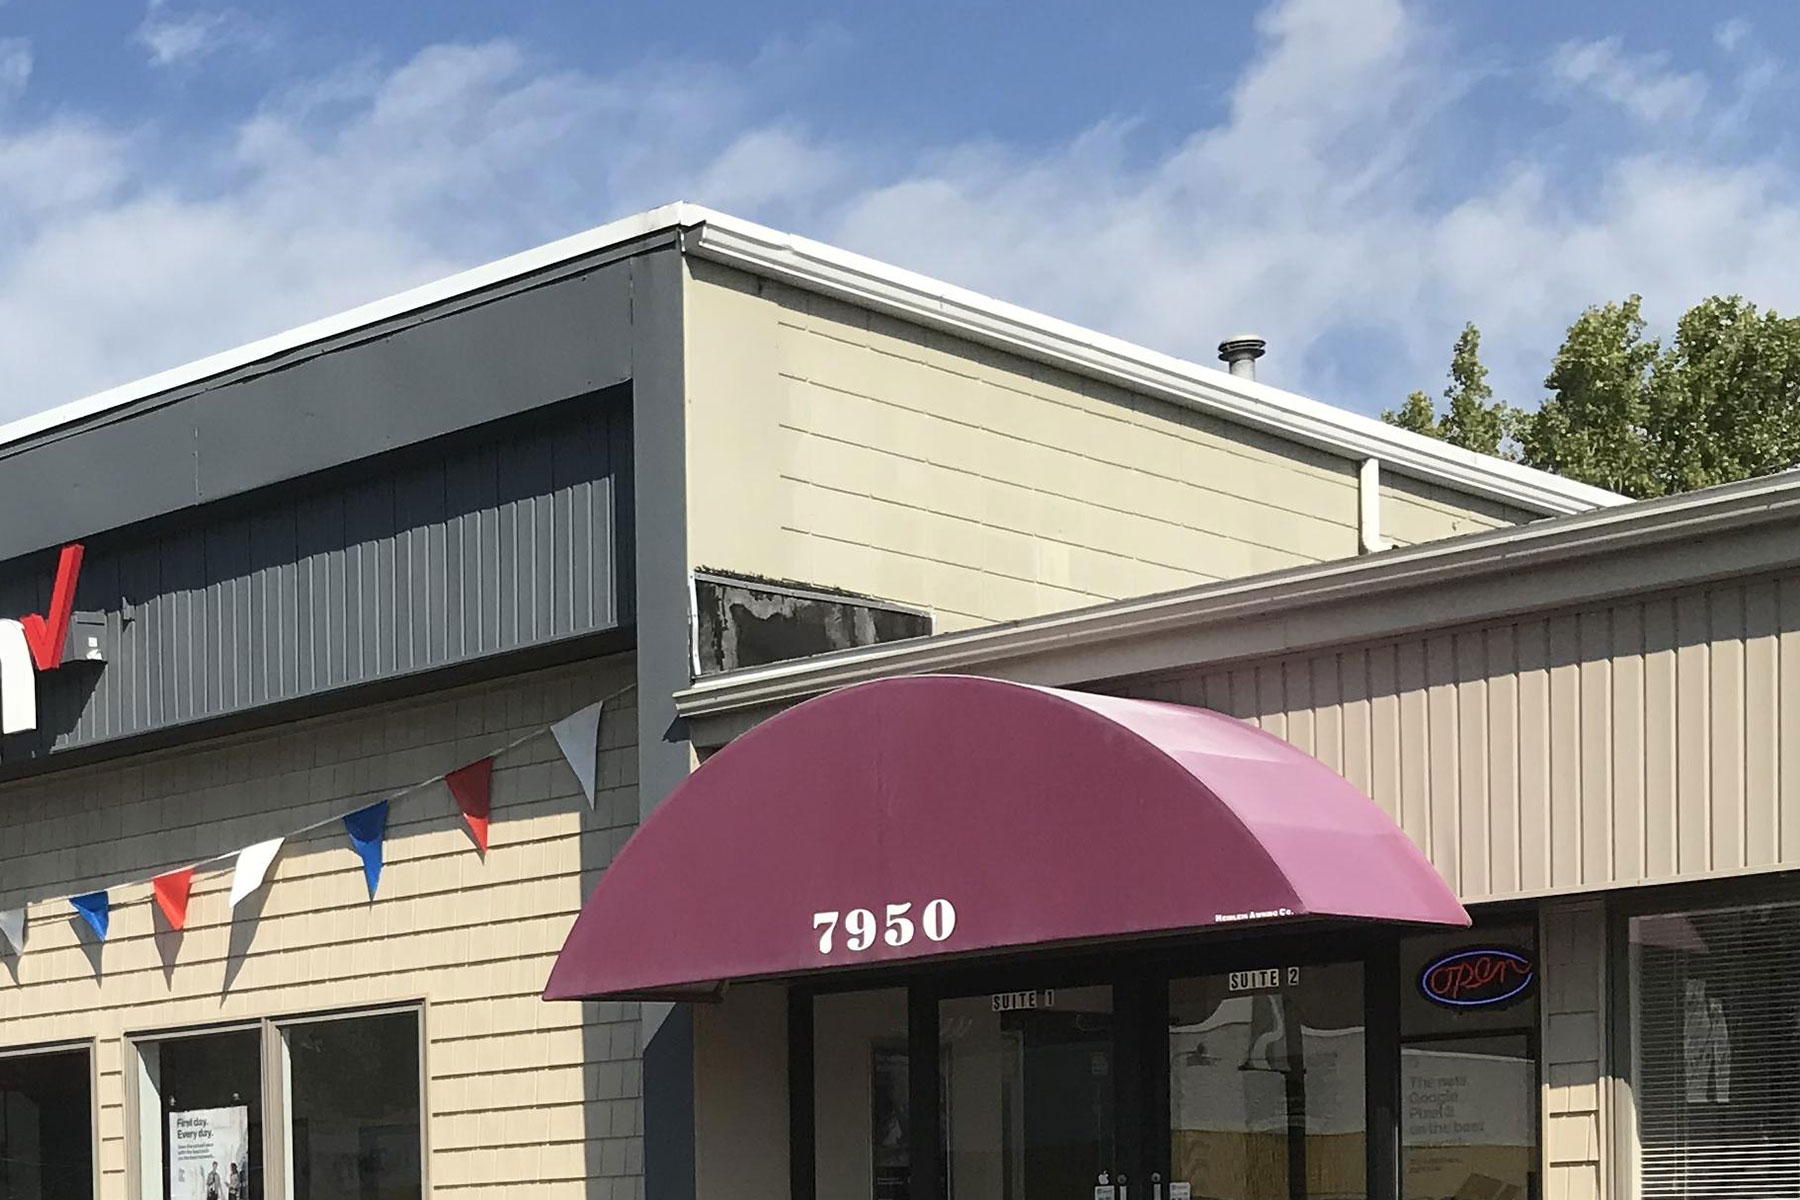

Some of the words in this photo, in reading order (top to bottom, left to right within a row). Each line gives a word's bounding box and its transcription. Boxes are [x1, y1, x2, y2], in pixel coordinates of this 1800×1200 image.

[813, 899, 956, 954] 7950
[1230, 970, 1277, 990] SUITE
[1289, 968, 1298, 985] 2
[992, 992, 1036, 1011] SUITE
[1046, 990, 1054, 1006] 1
[176, 1118, 193, 1128] First
[193, 1117, 209, 1129] day.
[177, 1129, 198, 1140] Every
[198, 1128, 214, 1139] day.
